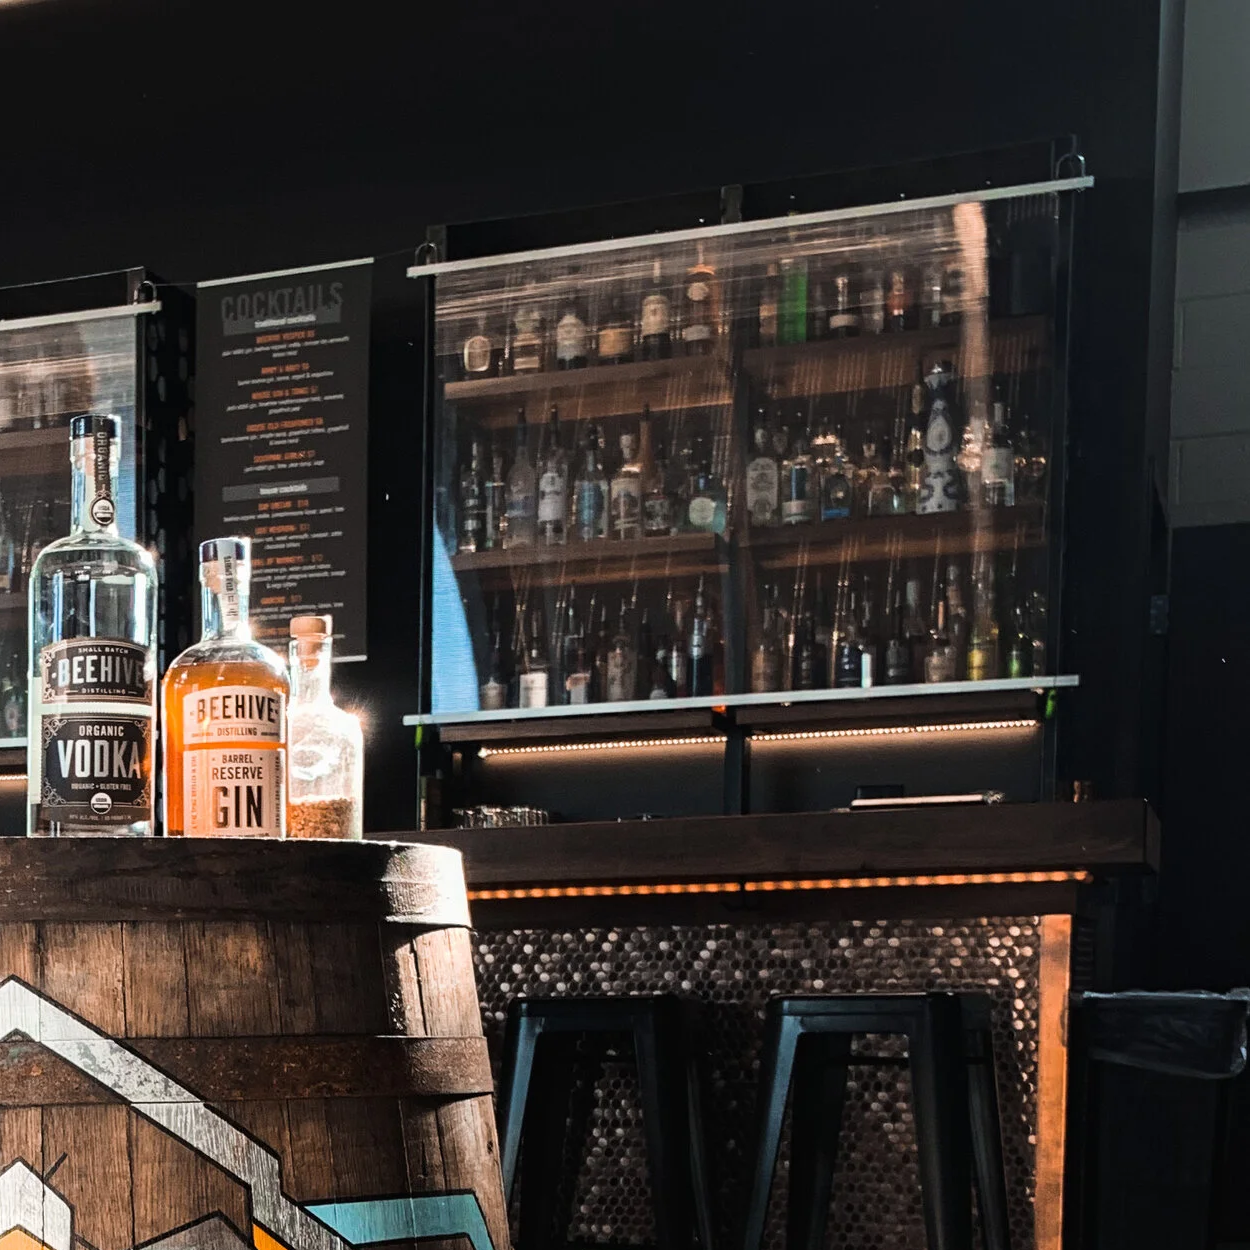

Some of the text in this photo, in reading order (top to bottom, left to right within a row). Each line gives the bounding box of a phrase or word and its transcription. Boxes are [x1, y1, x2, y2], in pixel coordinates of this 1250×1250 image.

[221, 282, 343, 321] COCKTAILS
[96, 431, 109, 481] ORGANIC
[105, 646, 129, 654] BATCH
[57, 655, 144, 688] BEEHIVE
[81, 687, 126, 695] DISTILLING
[197, 694, 276, 723] BEEHIVE
[78, 725, 125, 737] ORGANIC
[217, 727, 258, 737] DISTILLING
[57, 739, 142, 780] VODKA
[222, 754, 254, 764] BARREL
[212, 767, 263, 780] RESERVE
[212, 785, 263, 828] GIN
